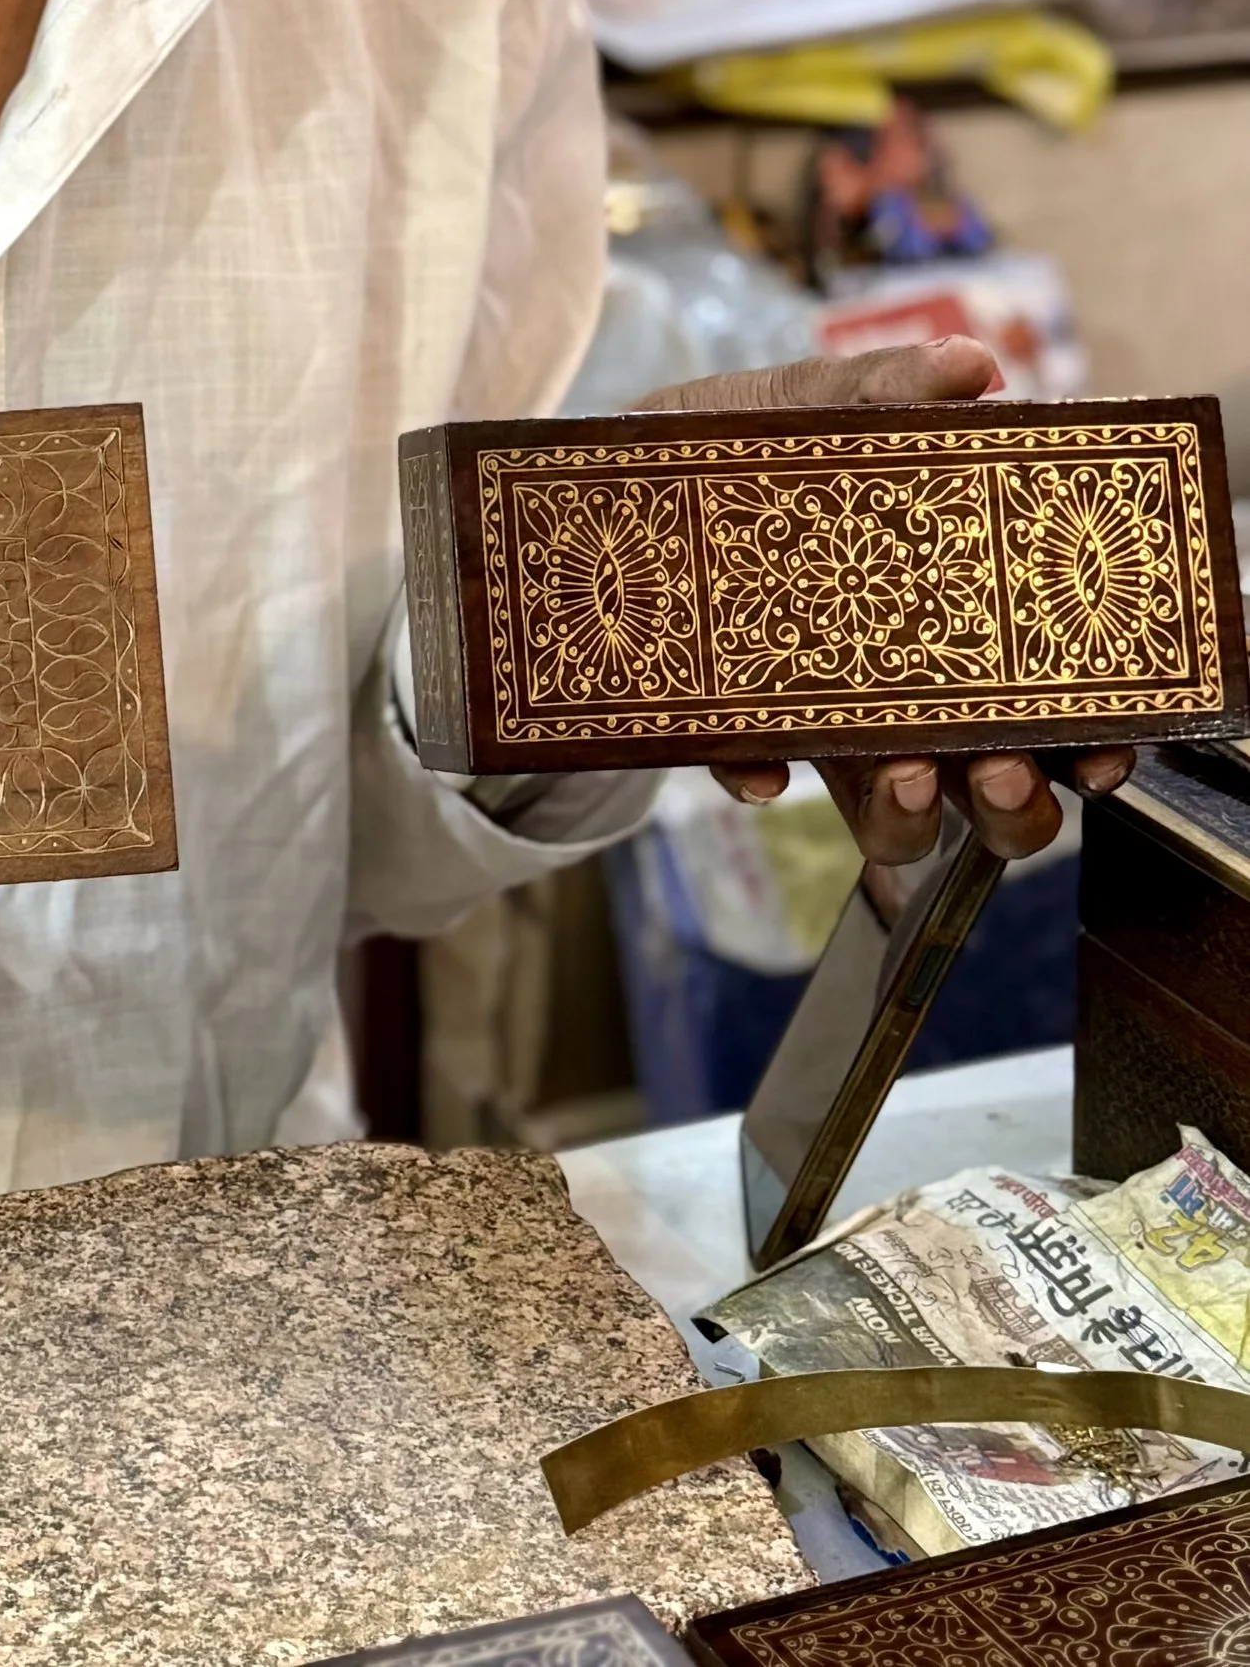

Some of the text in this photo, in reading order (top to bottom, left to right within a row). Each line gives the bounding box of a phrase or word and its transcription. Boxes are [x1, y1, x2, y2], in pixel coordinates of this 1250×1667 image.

[1144, 1210, 1230, 1273] 42
[855, 1259, 918, 1325] TICKETS
[850, 1297, 902, 1344] NOW
[911, 1326, 960, 1366] YOUR
